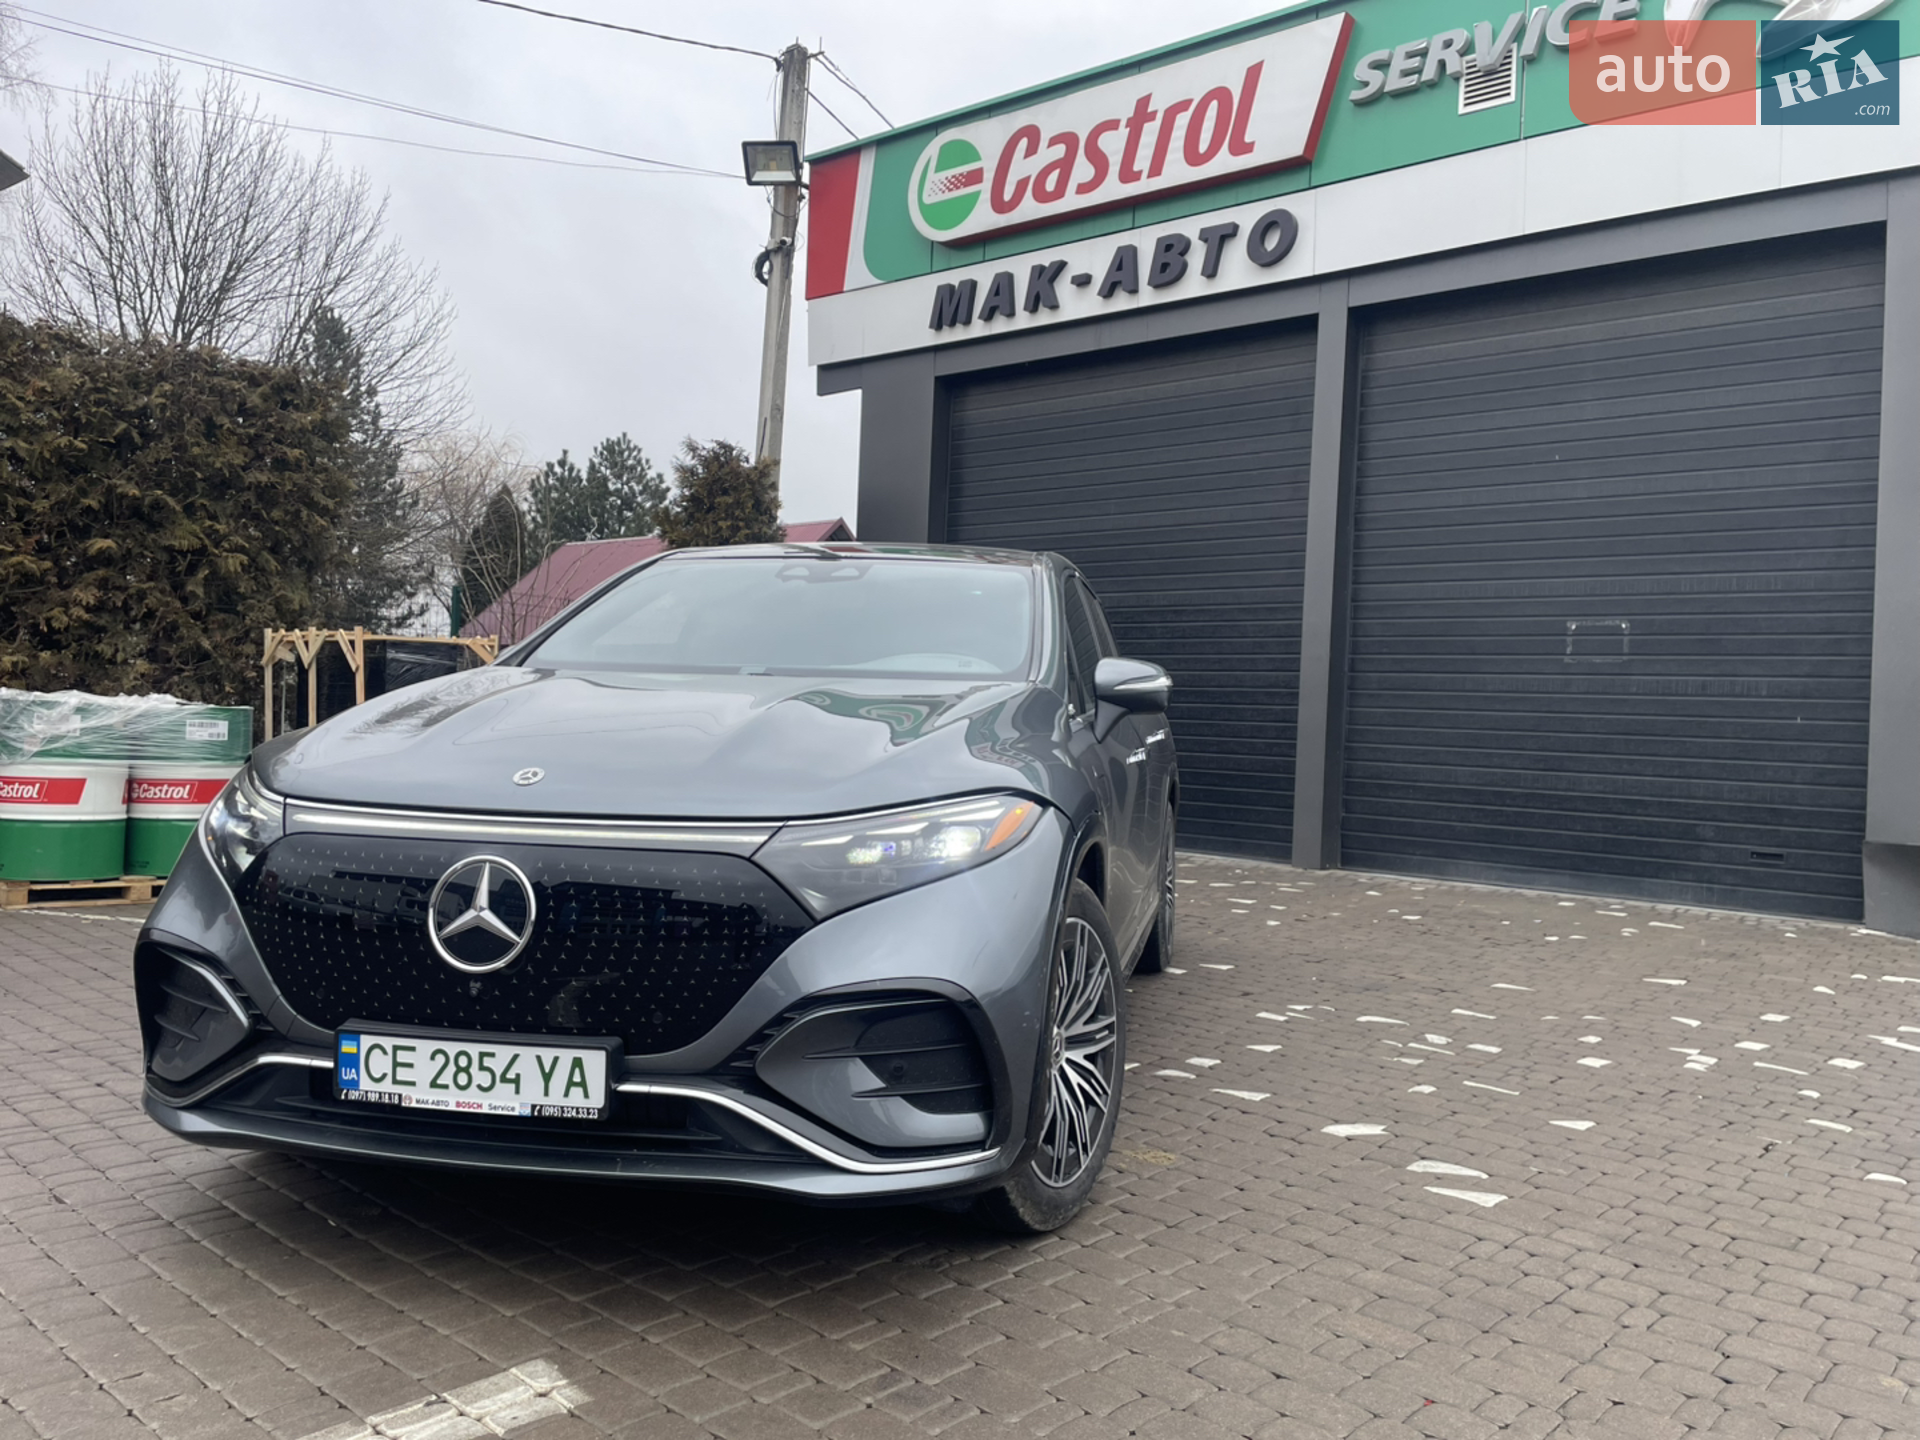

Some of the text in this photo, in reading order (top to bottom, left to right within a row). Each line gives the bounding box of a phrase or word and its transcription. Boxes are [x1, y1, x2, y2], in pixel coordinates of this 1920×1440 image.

[1349, 0, 1640, 104] SERVICE
[990, 59, 1264, 215] Castrol
[929, 208, 1299, 331] МАК-АВТО
[139, 782, 190, 799] Castrol
[342, 1067, 358, 1080] UA
[364, 1043, 589, 1099] CE 2854 YA
[455, 1100, 516, 1113] BOSCH Service
[541, 1105, 598, 1119] (095) 324.33.23
